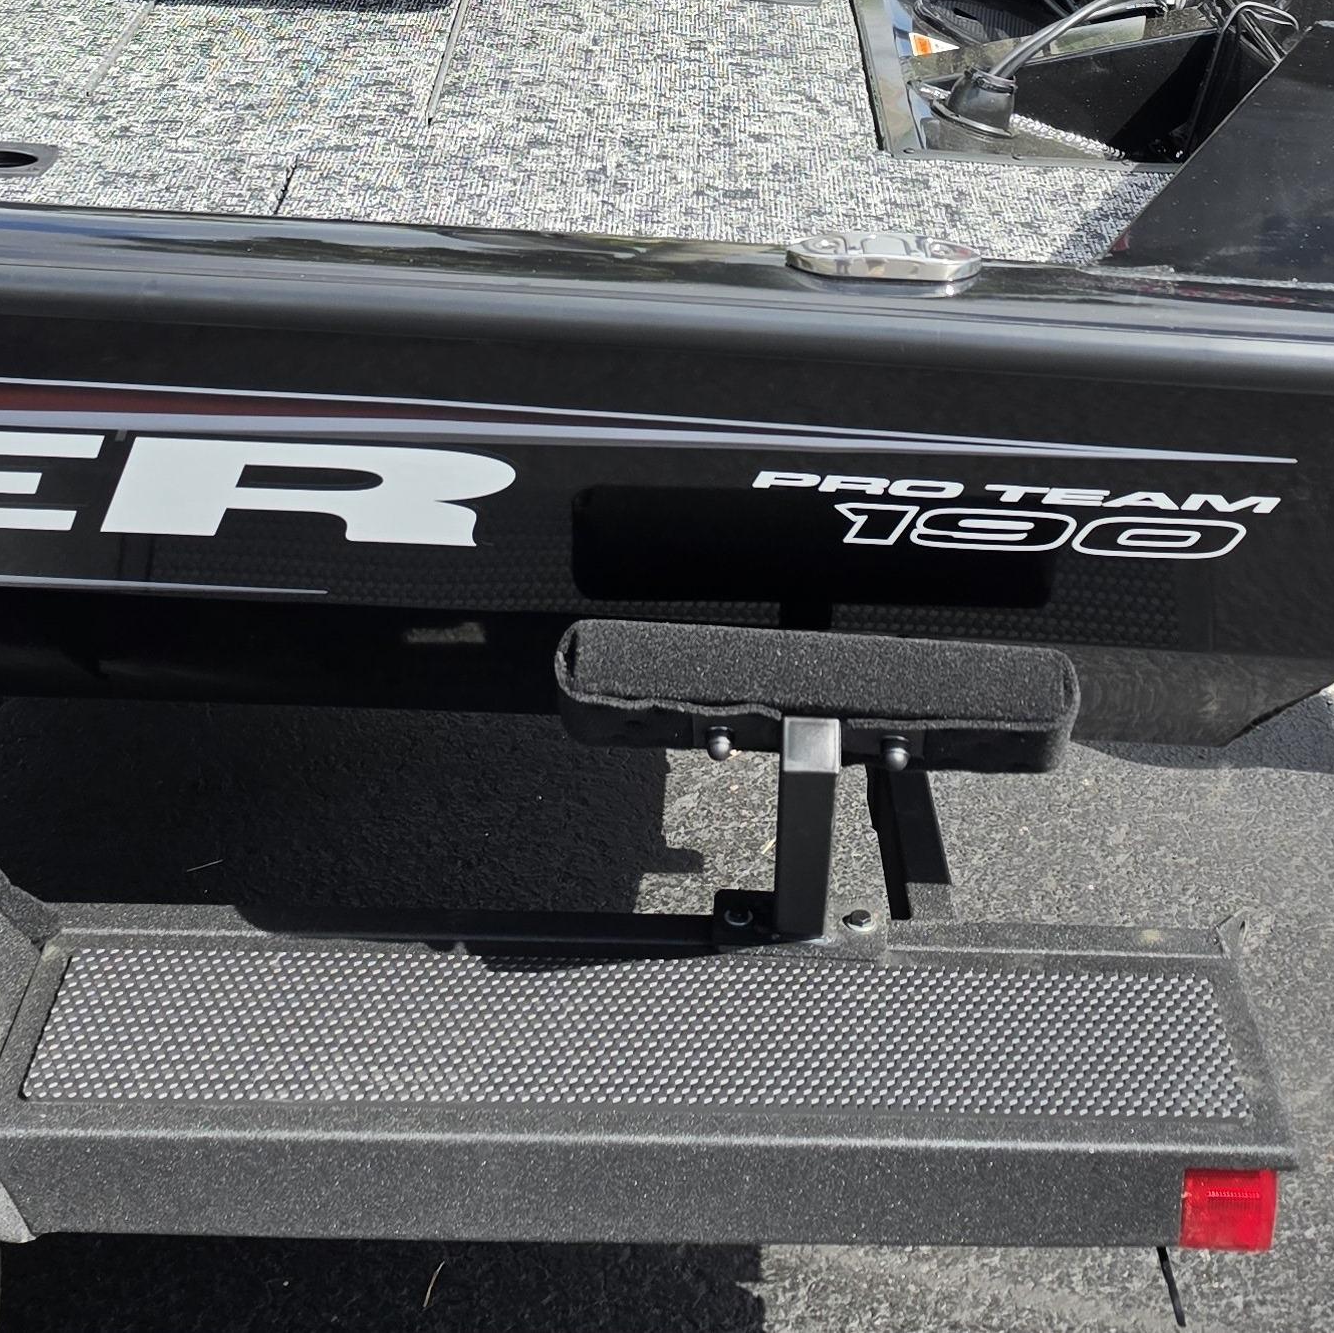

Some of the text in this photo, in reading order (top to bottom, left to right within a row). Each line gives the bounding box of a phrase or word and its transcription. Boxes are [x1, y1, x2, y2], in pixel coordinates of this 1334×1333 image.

[751, 470, 1282, 513] PRO TEAM
[833, 502, 1248, 560] 190
